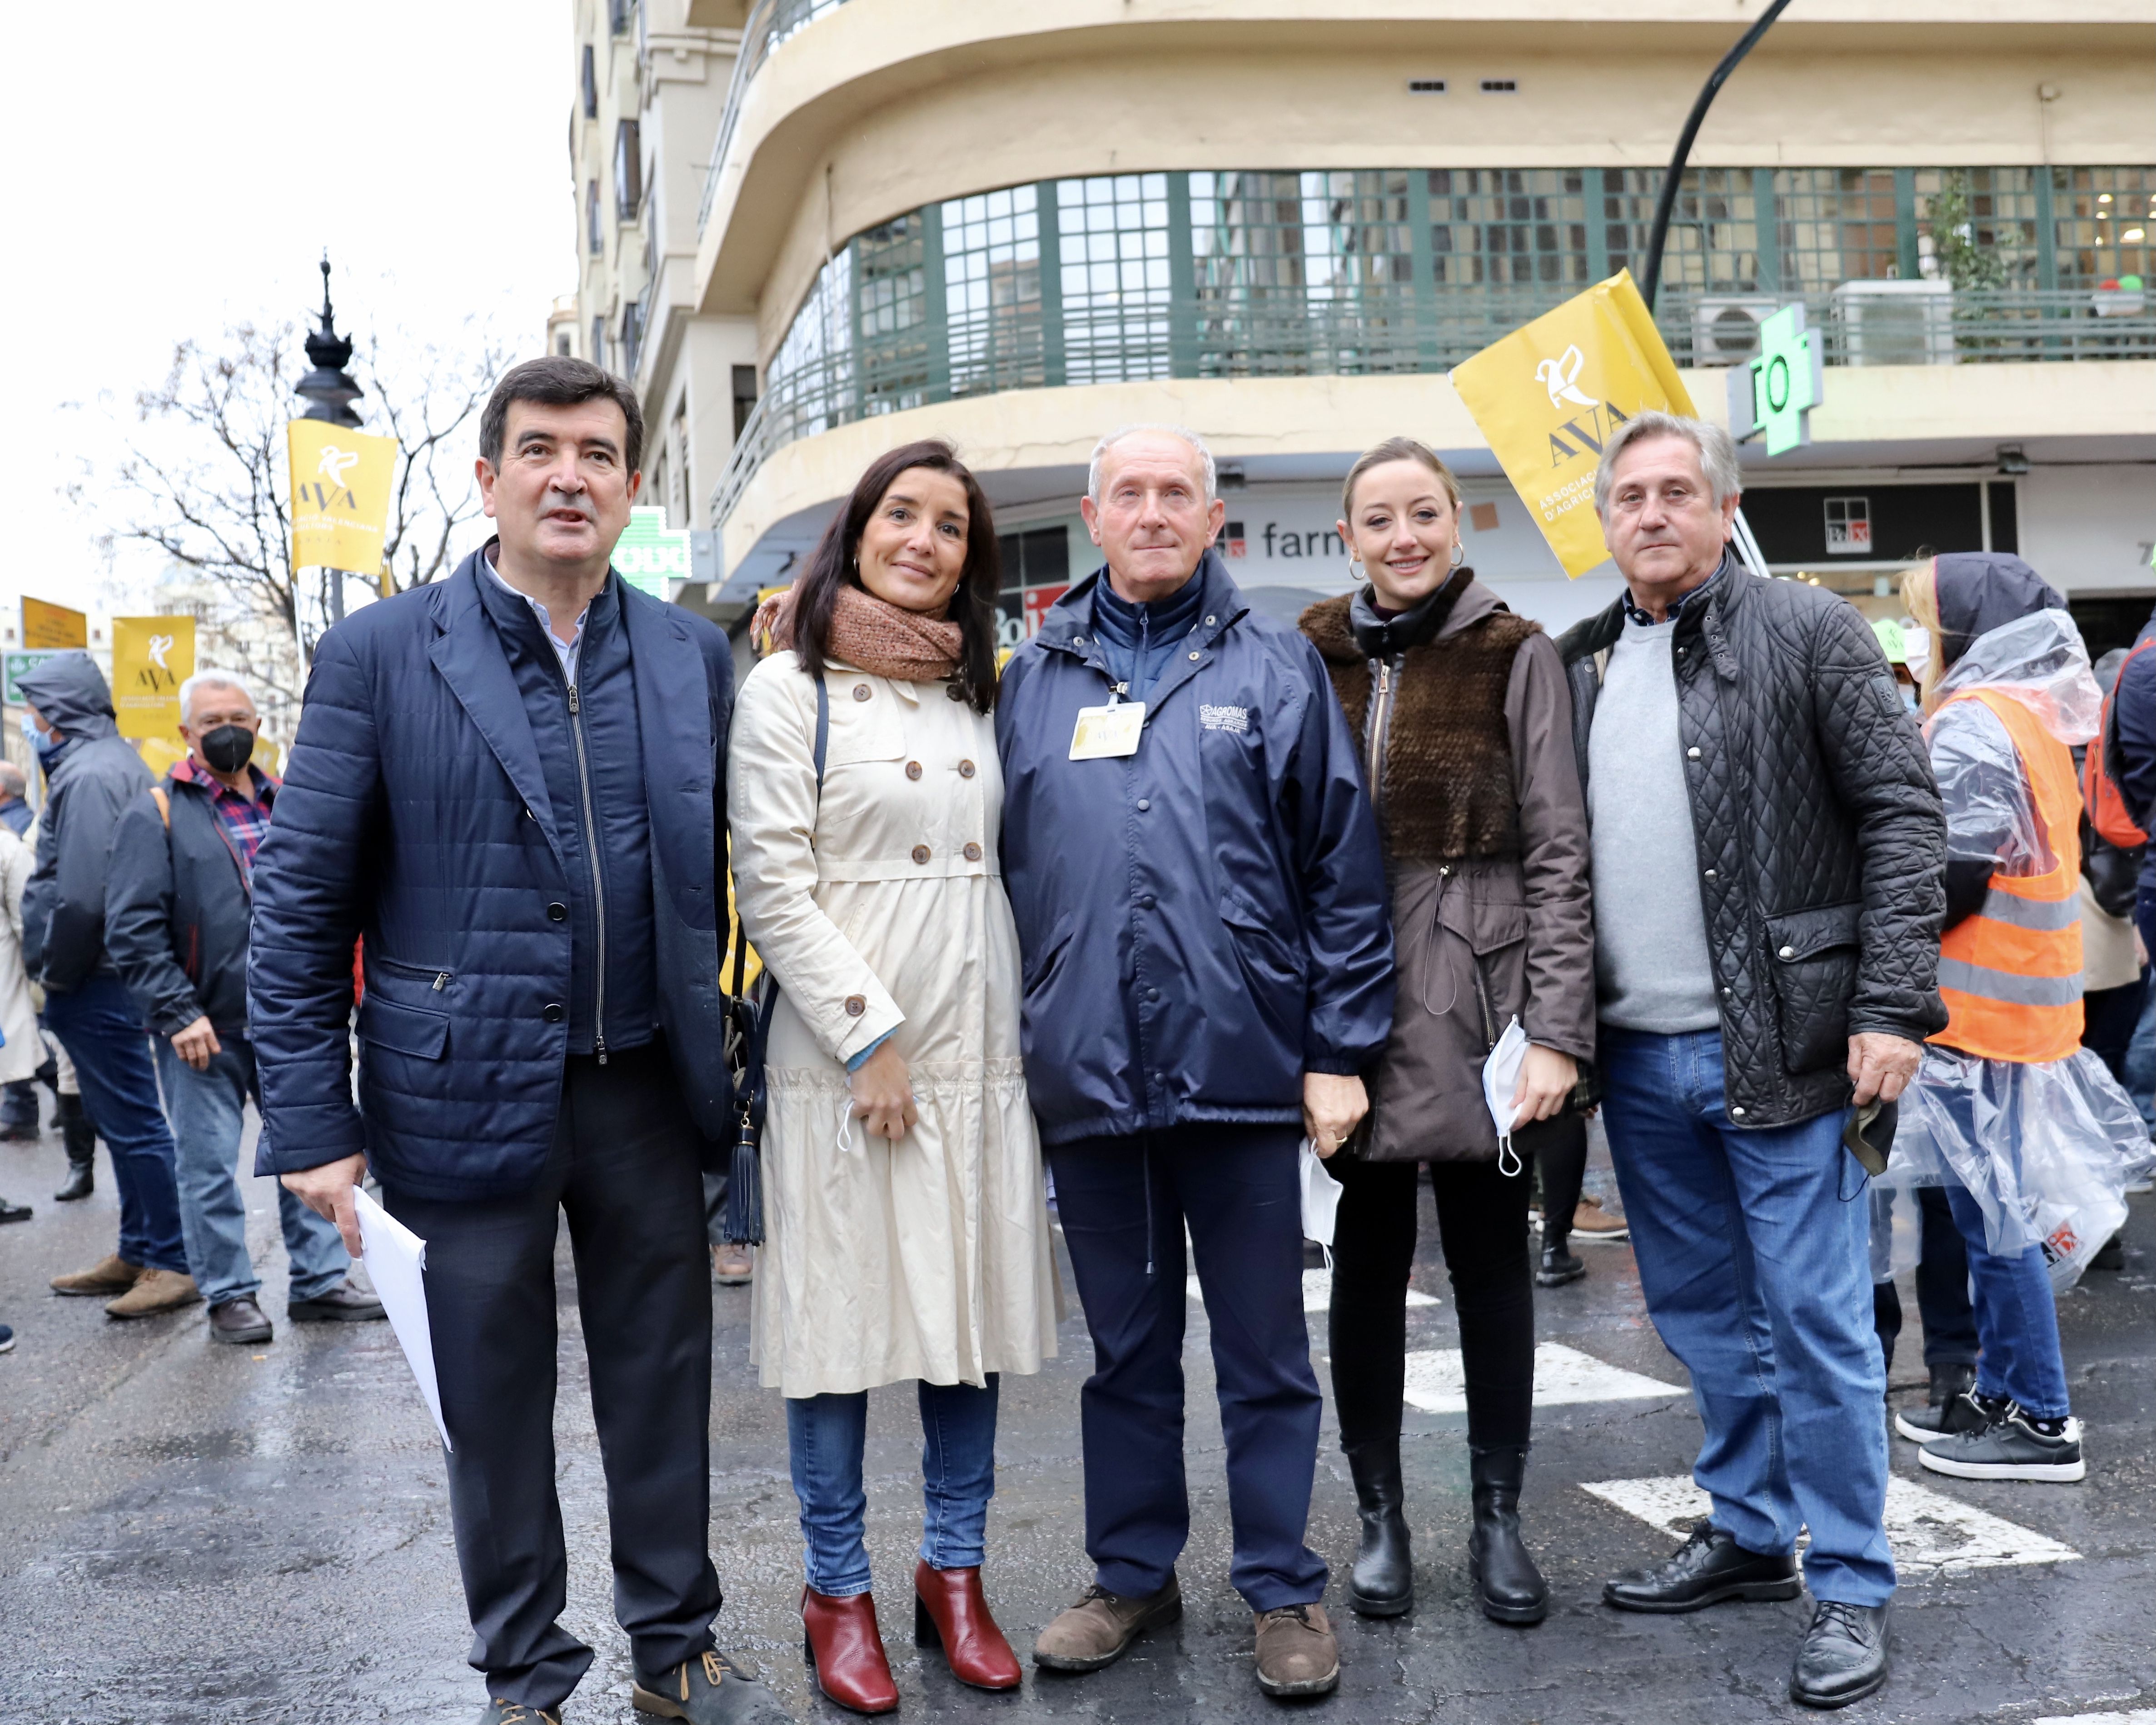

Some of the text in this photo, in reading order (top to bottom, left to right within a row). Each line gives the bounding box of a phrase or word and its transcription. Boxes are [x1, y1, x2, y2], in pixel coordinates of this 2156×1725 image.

[1549, 401, 1629, 469] AVA
[293, 482, 358, 512] AVA
[136, 669, 176, 692] AVA
[1211, 706, 1247, 719] AGROMAS
[1221, 725, 1240, 734] ASAJA
[1223, 718, 1247, 727] AGRARIOS
